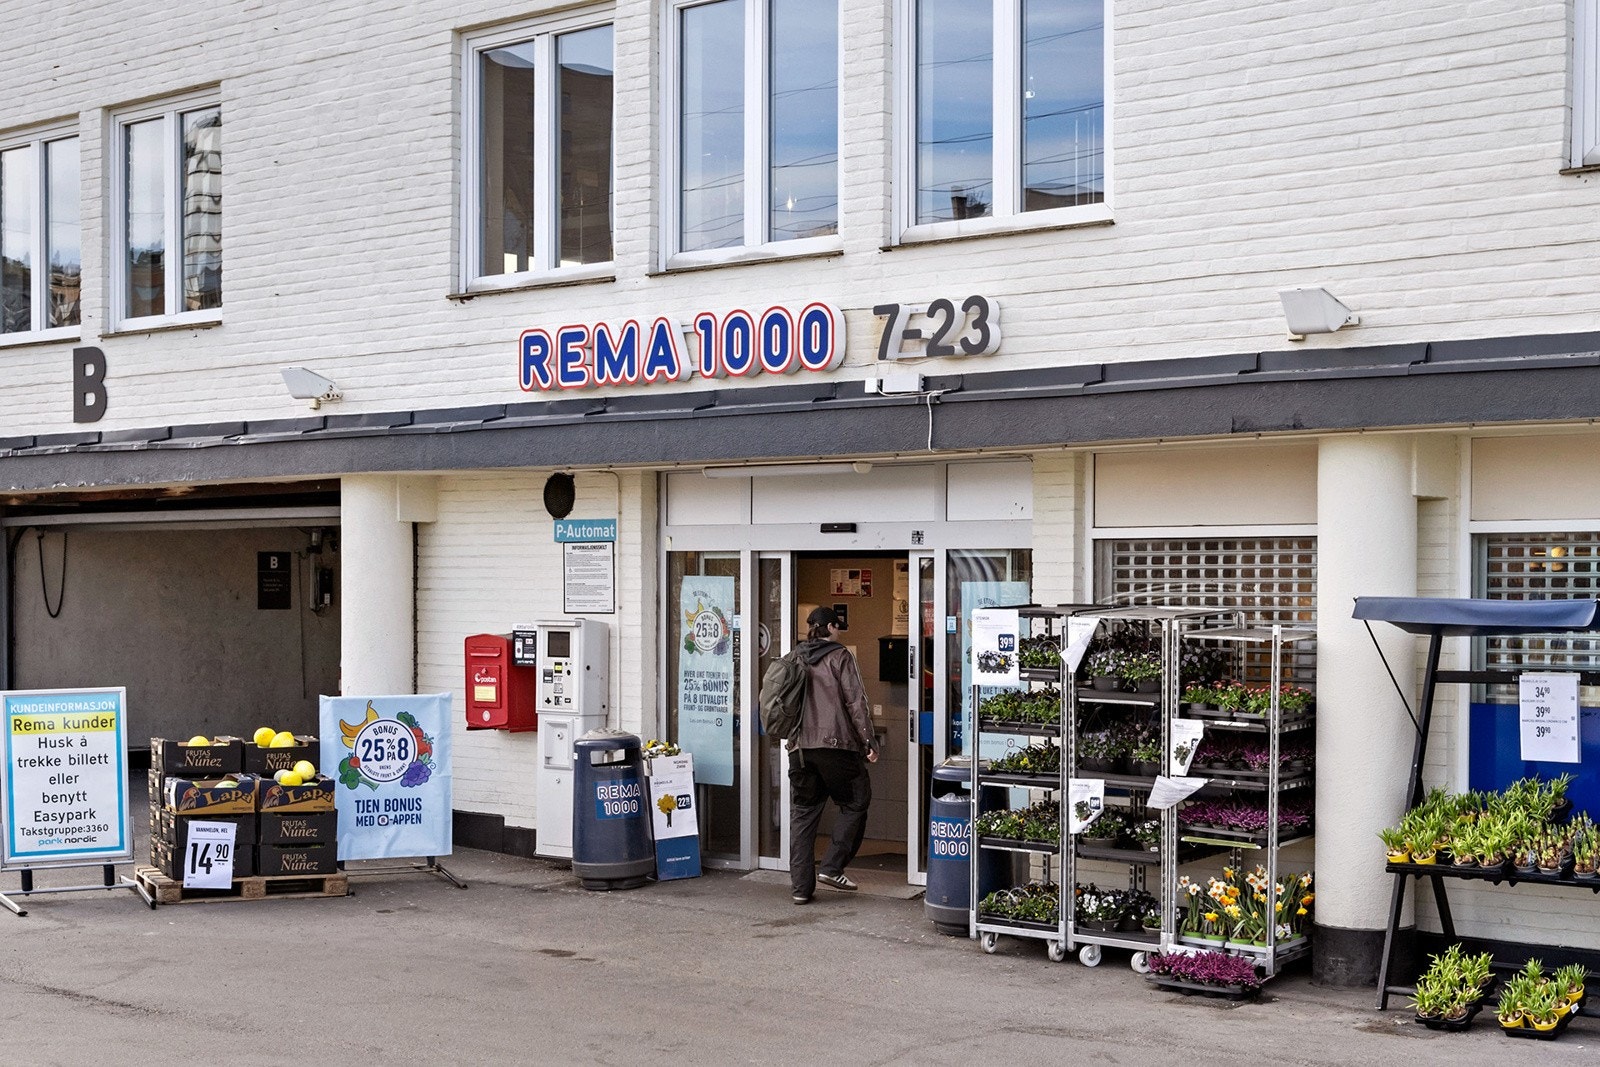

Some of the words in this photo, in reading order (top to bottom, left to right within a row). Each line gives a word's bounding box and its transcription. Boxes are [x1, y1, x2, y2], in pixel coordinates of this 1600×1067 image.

[518, 316, 681, 392] REMA
[695, 301, 837, 379] 1000
[873, 295, 992, 360] 7-23
[73, 346, 108, 423] B
[556, 524, 615, 538] P-Automat
[270, 556, 278, 569] B
[695, 622, 708, 638] 25
[713, 623, 719, 638] 8
[1000, 637, 1009, 649] 39
[684, 678, 701, 692] 25%
[703, 680, 729, 693] BONUS
[1535, 686, 1544, 698] 34
[683, 690, 692, 704] PÅ
[693, 694, 698, 704] 8
[699, 694, 728, 706] UTVALGTE
[10, 701, 116, 714] KUNDEINFORMASJON
[1535, 706, 1545, 718] 39
[13, 718, 55, 732] Rema
[63, 716, 115, 730] kunder
[372, 724, 399, 736] BONUS
[1535, 726, 1545, 738] 39
[38, 736, 73, 749] Husk
[80, 735, 88, 748] å
[361, 738, 385, 762] 25
[397, 737, 409, 761] 8
[17, 756, 61, 768] trekke
[68, 754, 109, 766] billett
[49, 773, 80, 785] eller
[42, 791, 88, 806] benytt
[597, 783, 641, 800] REMA
[354, 799, 380, 814] TJEN
[384, 797, 423, 812] BONUS
[603, 800, 639, 815] 1000
[34, 808, 96, 824] Easypark
[356, 814, 375, 827] MED
[20, 823, 109, 838] Takstgruppe:3360
[931, 821, 972, 838] REMA
[38, 837, 63, 847] park
[64, 835, 97, 844] nordic
[934, 839, 969, 856] 1000
[191, 843, 213, 875] 14
[215, 844, 229, 859] 90
